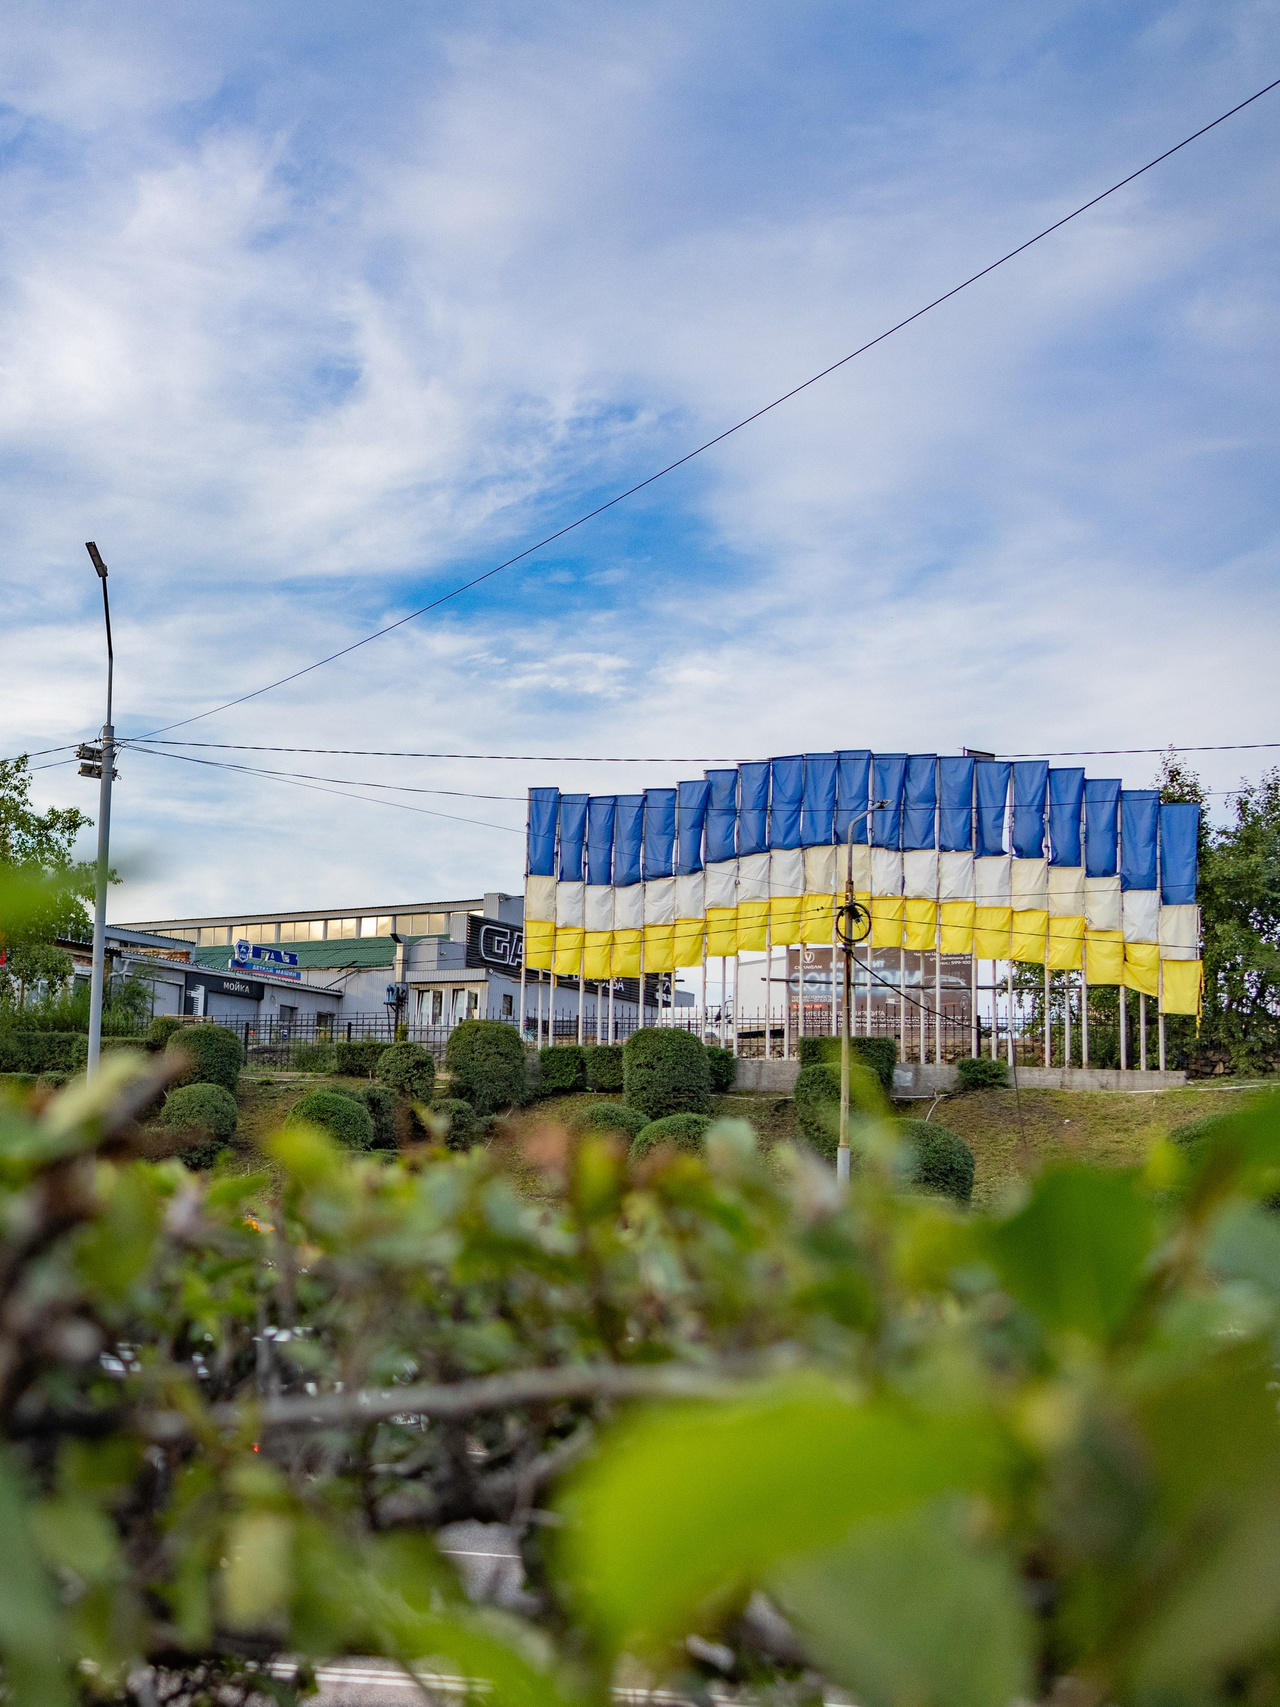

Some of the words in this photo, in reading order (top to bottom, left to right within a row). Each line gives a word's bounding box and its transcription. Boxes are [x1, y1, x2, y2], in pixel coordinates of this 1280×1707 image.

[252, 945, 299, 966] ГАЗ
[275, 969, 297, 977] МАШИН
[223, 980, 250, 994] МОЙКА
